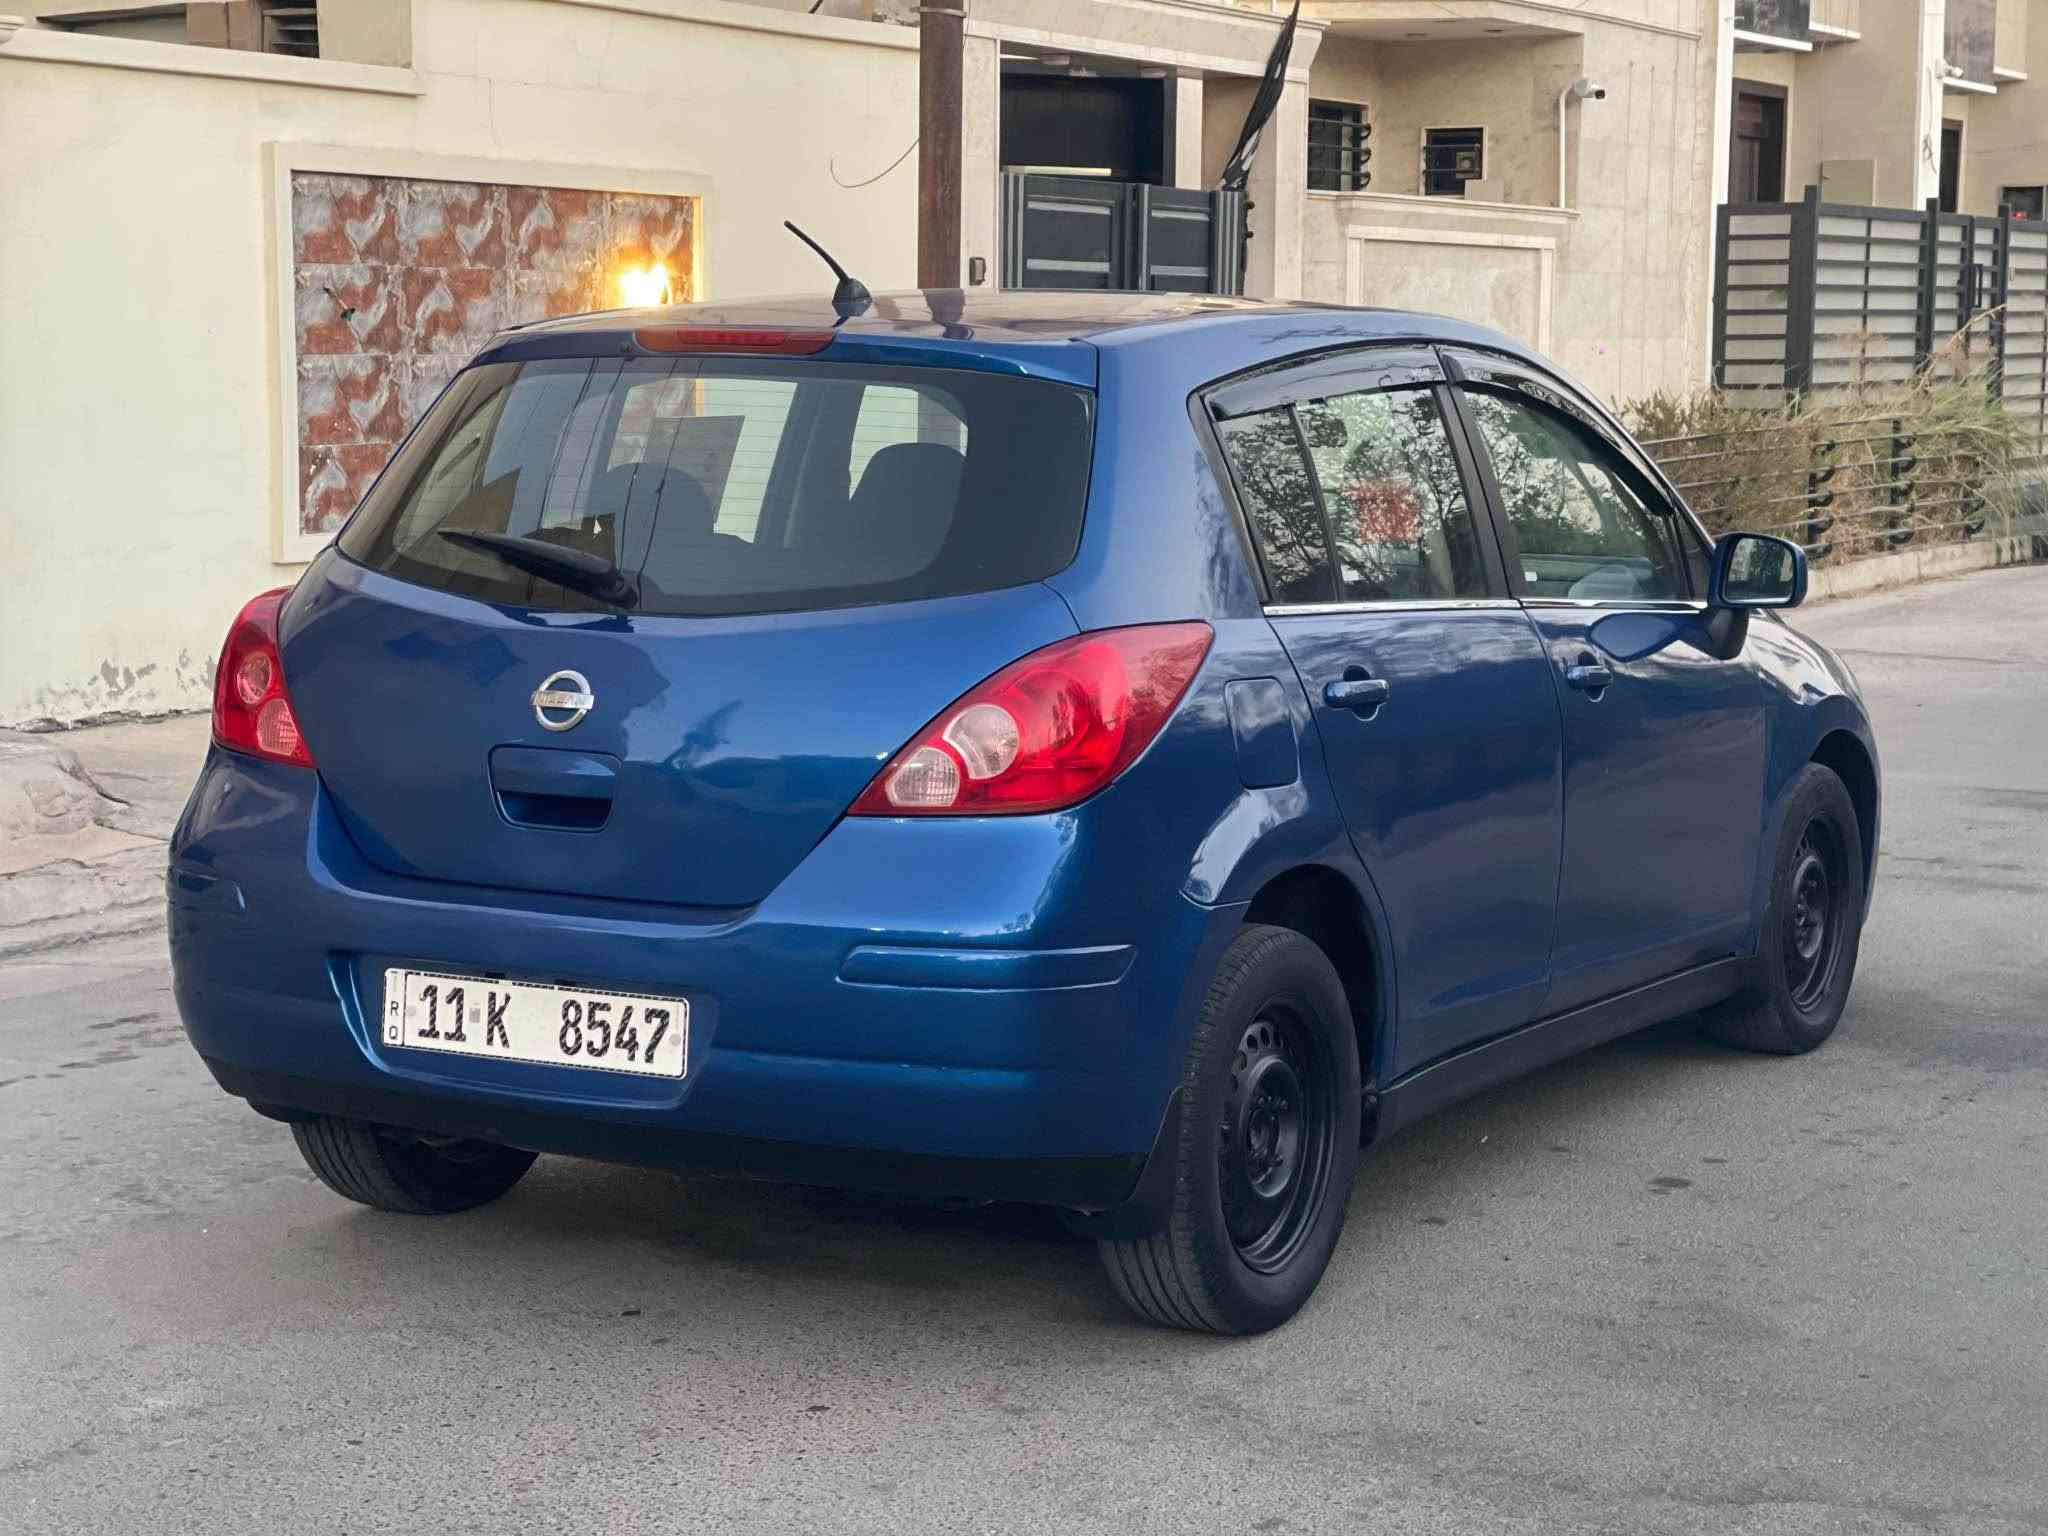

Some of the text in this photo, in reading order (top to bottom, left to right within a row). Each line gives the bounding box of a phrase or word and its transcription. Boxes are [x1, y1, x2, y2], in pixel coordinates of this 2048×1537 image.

[418, 984, 670, 1063] 11 K 8547
